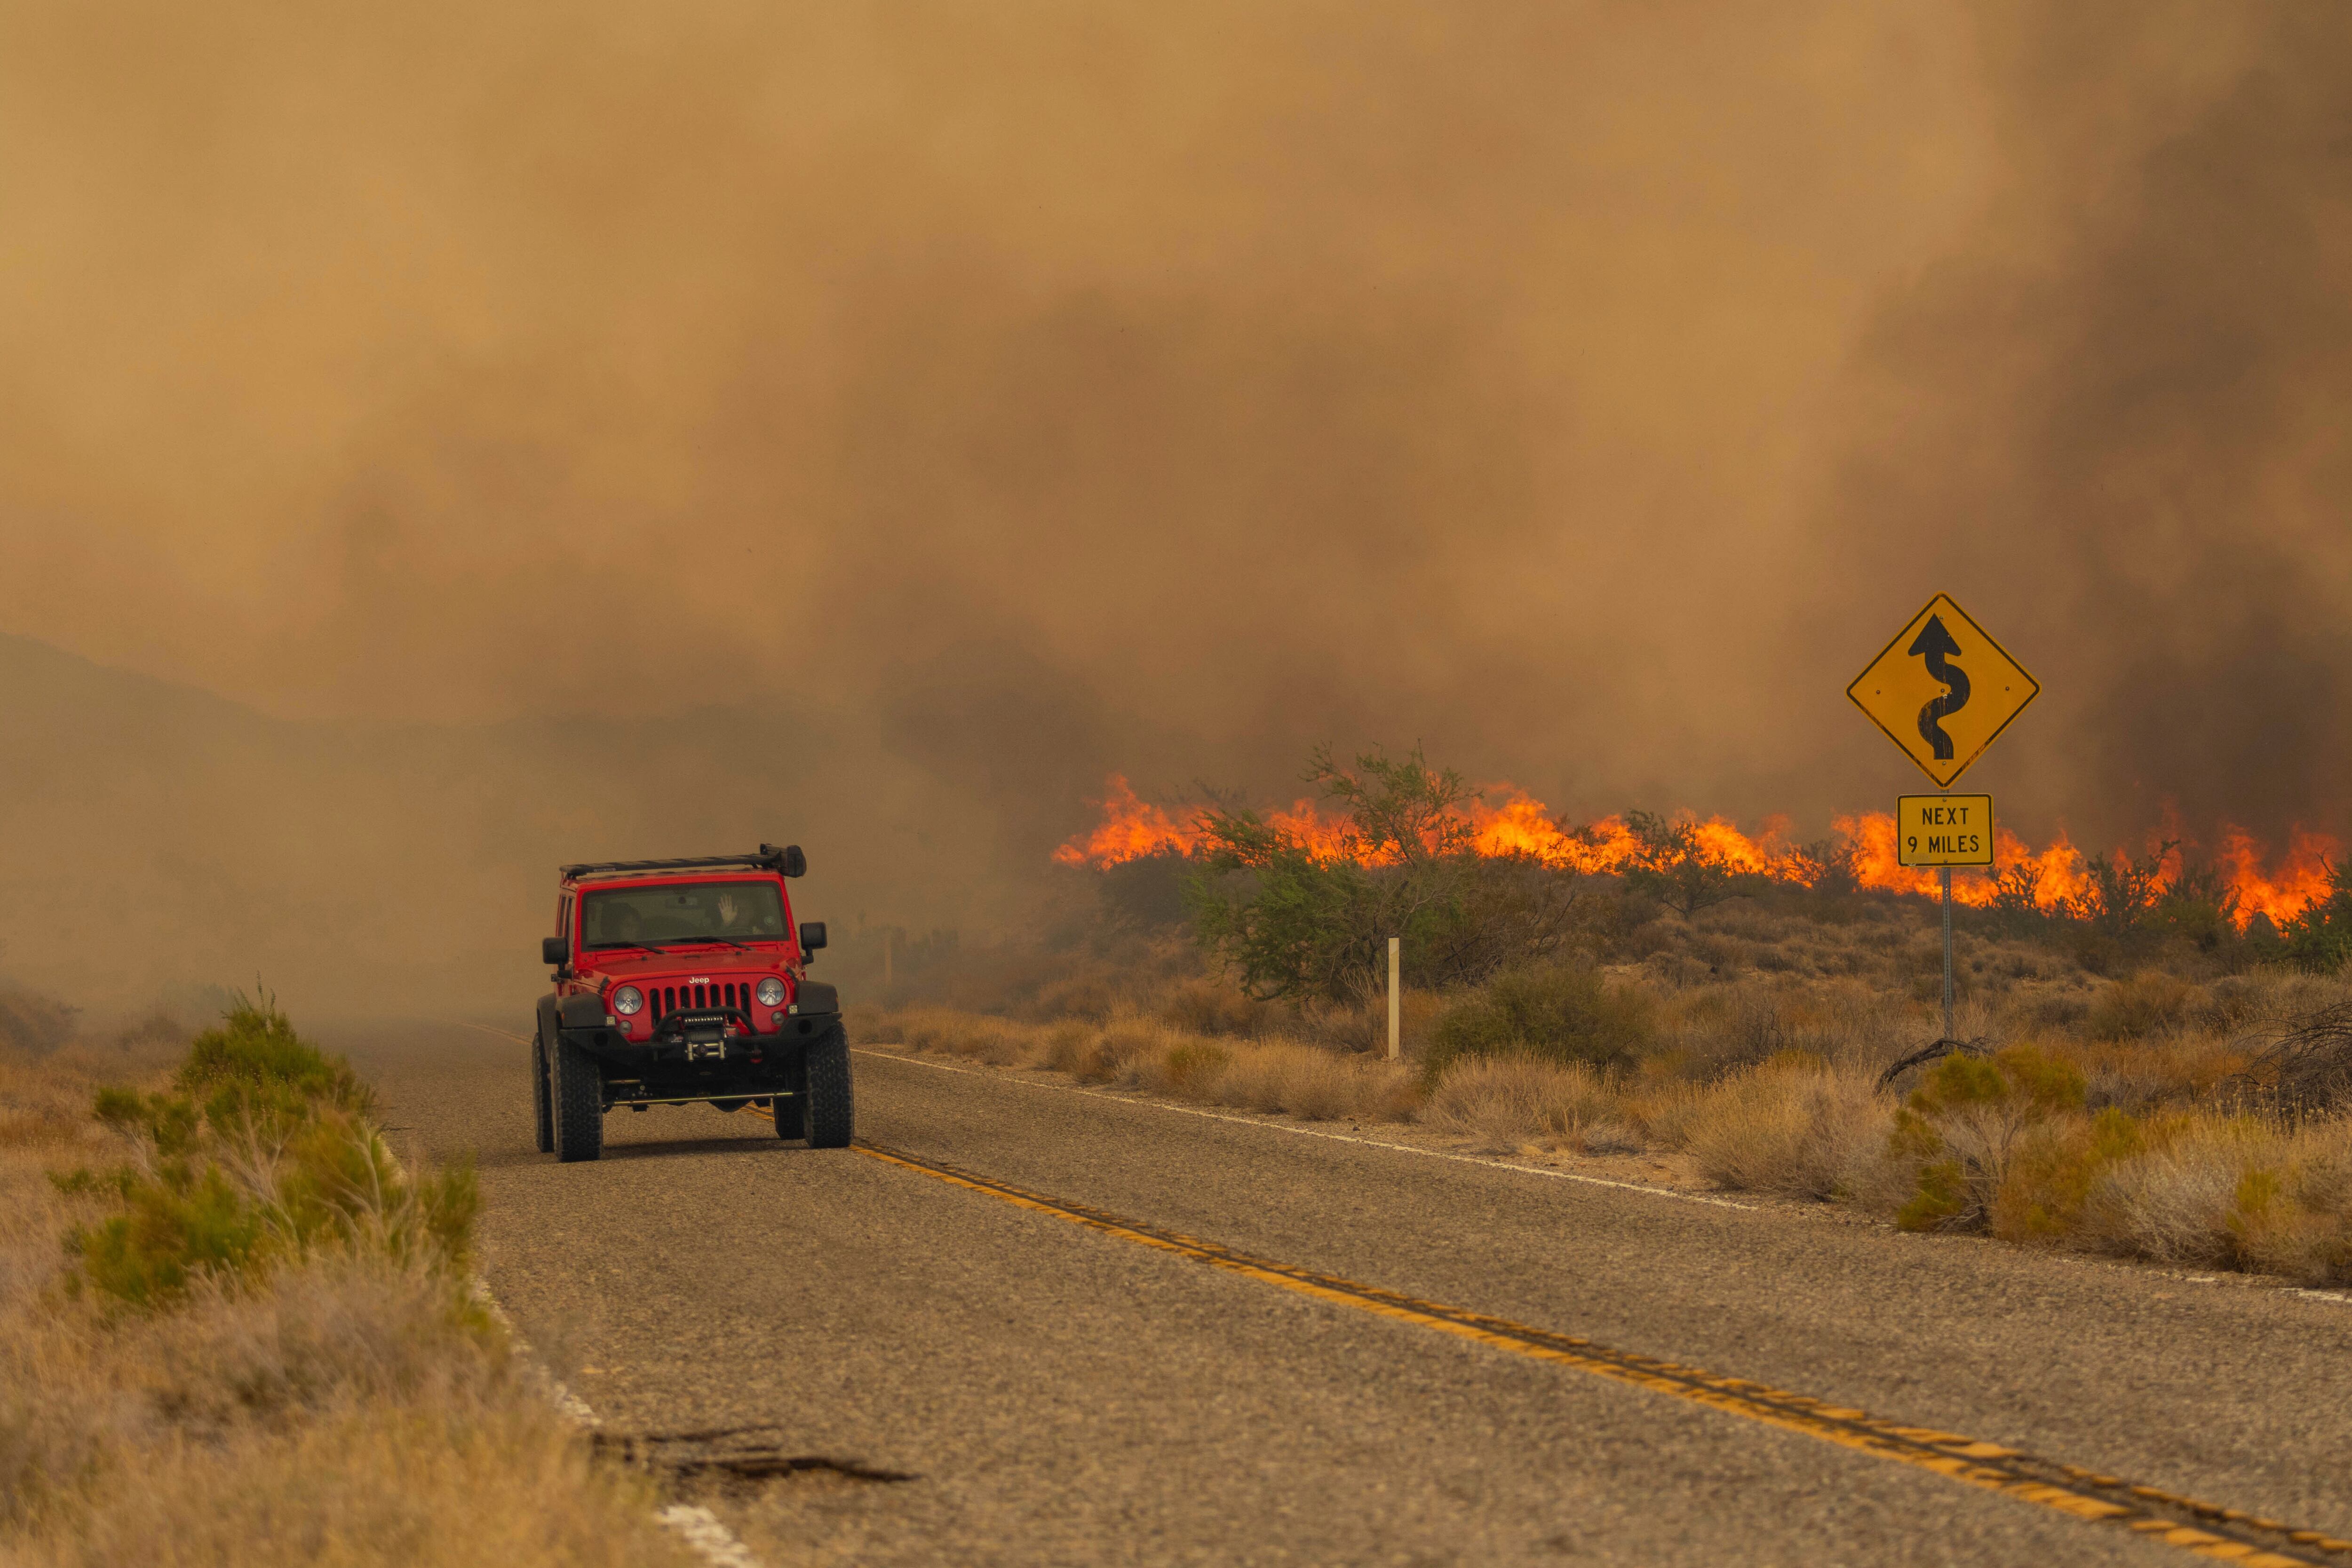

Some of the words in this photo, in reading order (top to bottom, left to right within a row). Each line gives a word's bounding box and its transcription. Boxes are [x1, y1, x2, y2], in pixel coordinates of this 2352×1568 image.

[1923, 808, 1969, 825] NEXT
[1907, 836, 1918, 853] 9
[1929, 835, 1979, 853] MILES
